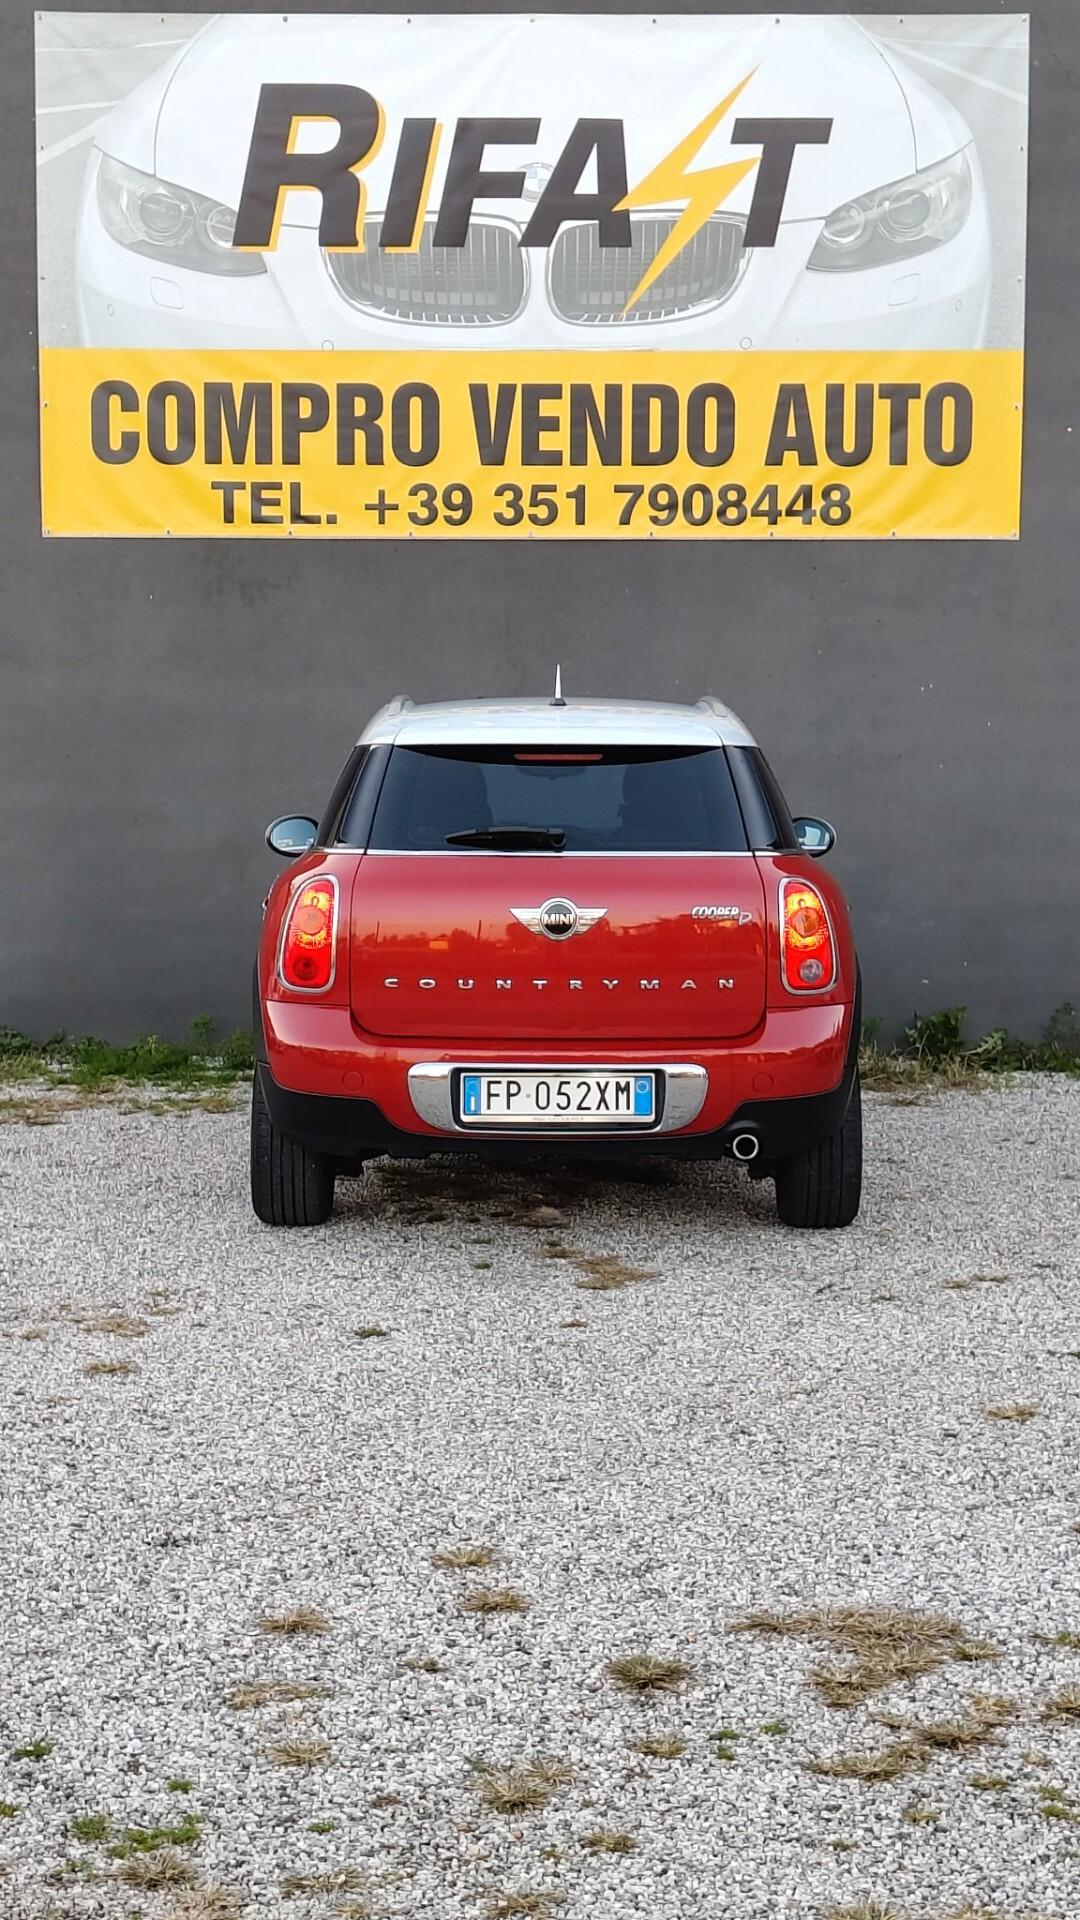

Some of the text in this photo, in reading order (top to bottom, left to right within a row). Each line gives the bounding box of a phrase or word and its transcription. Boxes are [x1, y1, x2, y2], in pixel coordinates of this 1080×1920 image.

[91, 380, 974, 468] COMPRO VENDO AUTO
[211, 481, 852, 527] TEL. +39 351 7908448
[542, 912, 575, 925] MINI
[691, 906, 753, 926] COOPER D
[383, 977, 736, 991] COUNTRYMAN
[486, 1080, 631, 1111] FP 052XM
